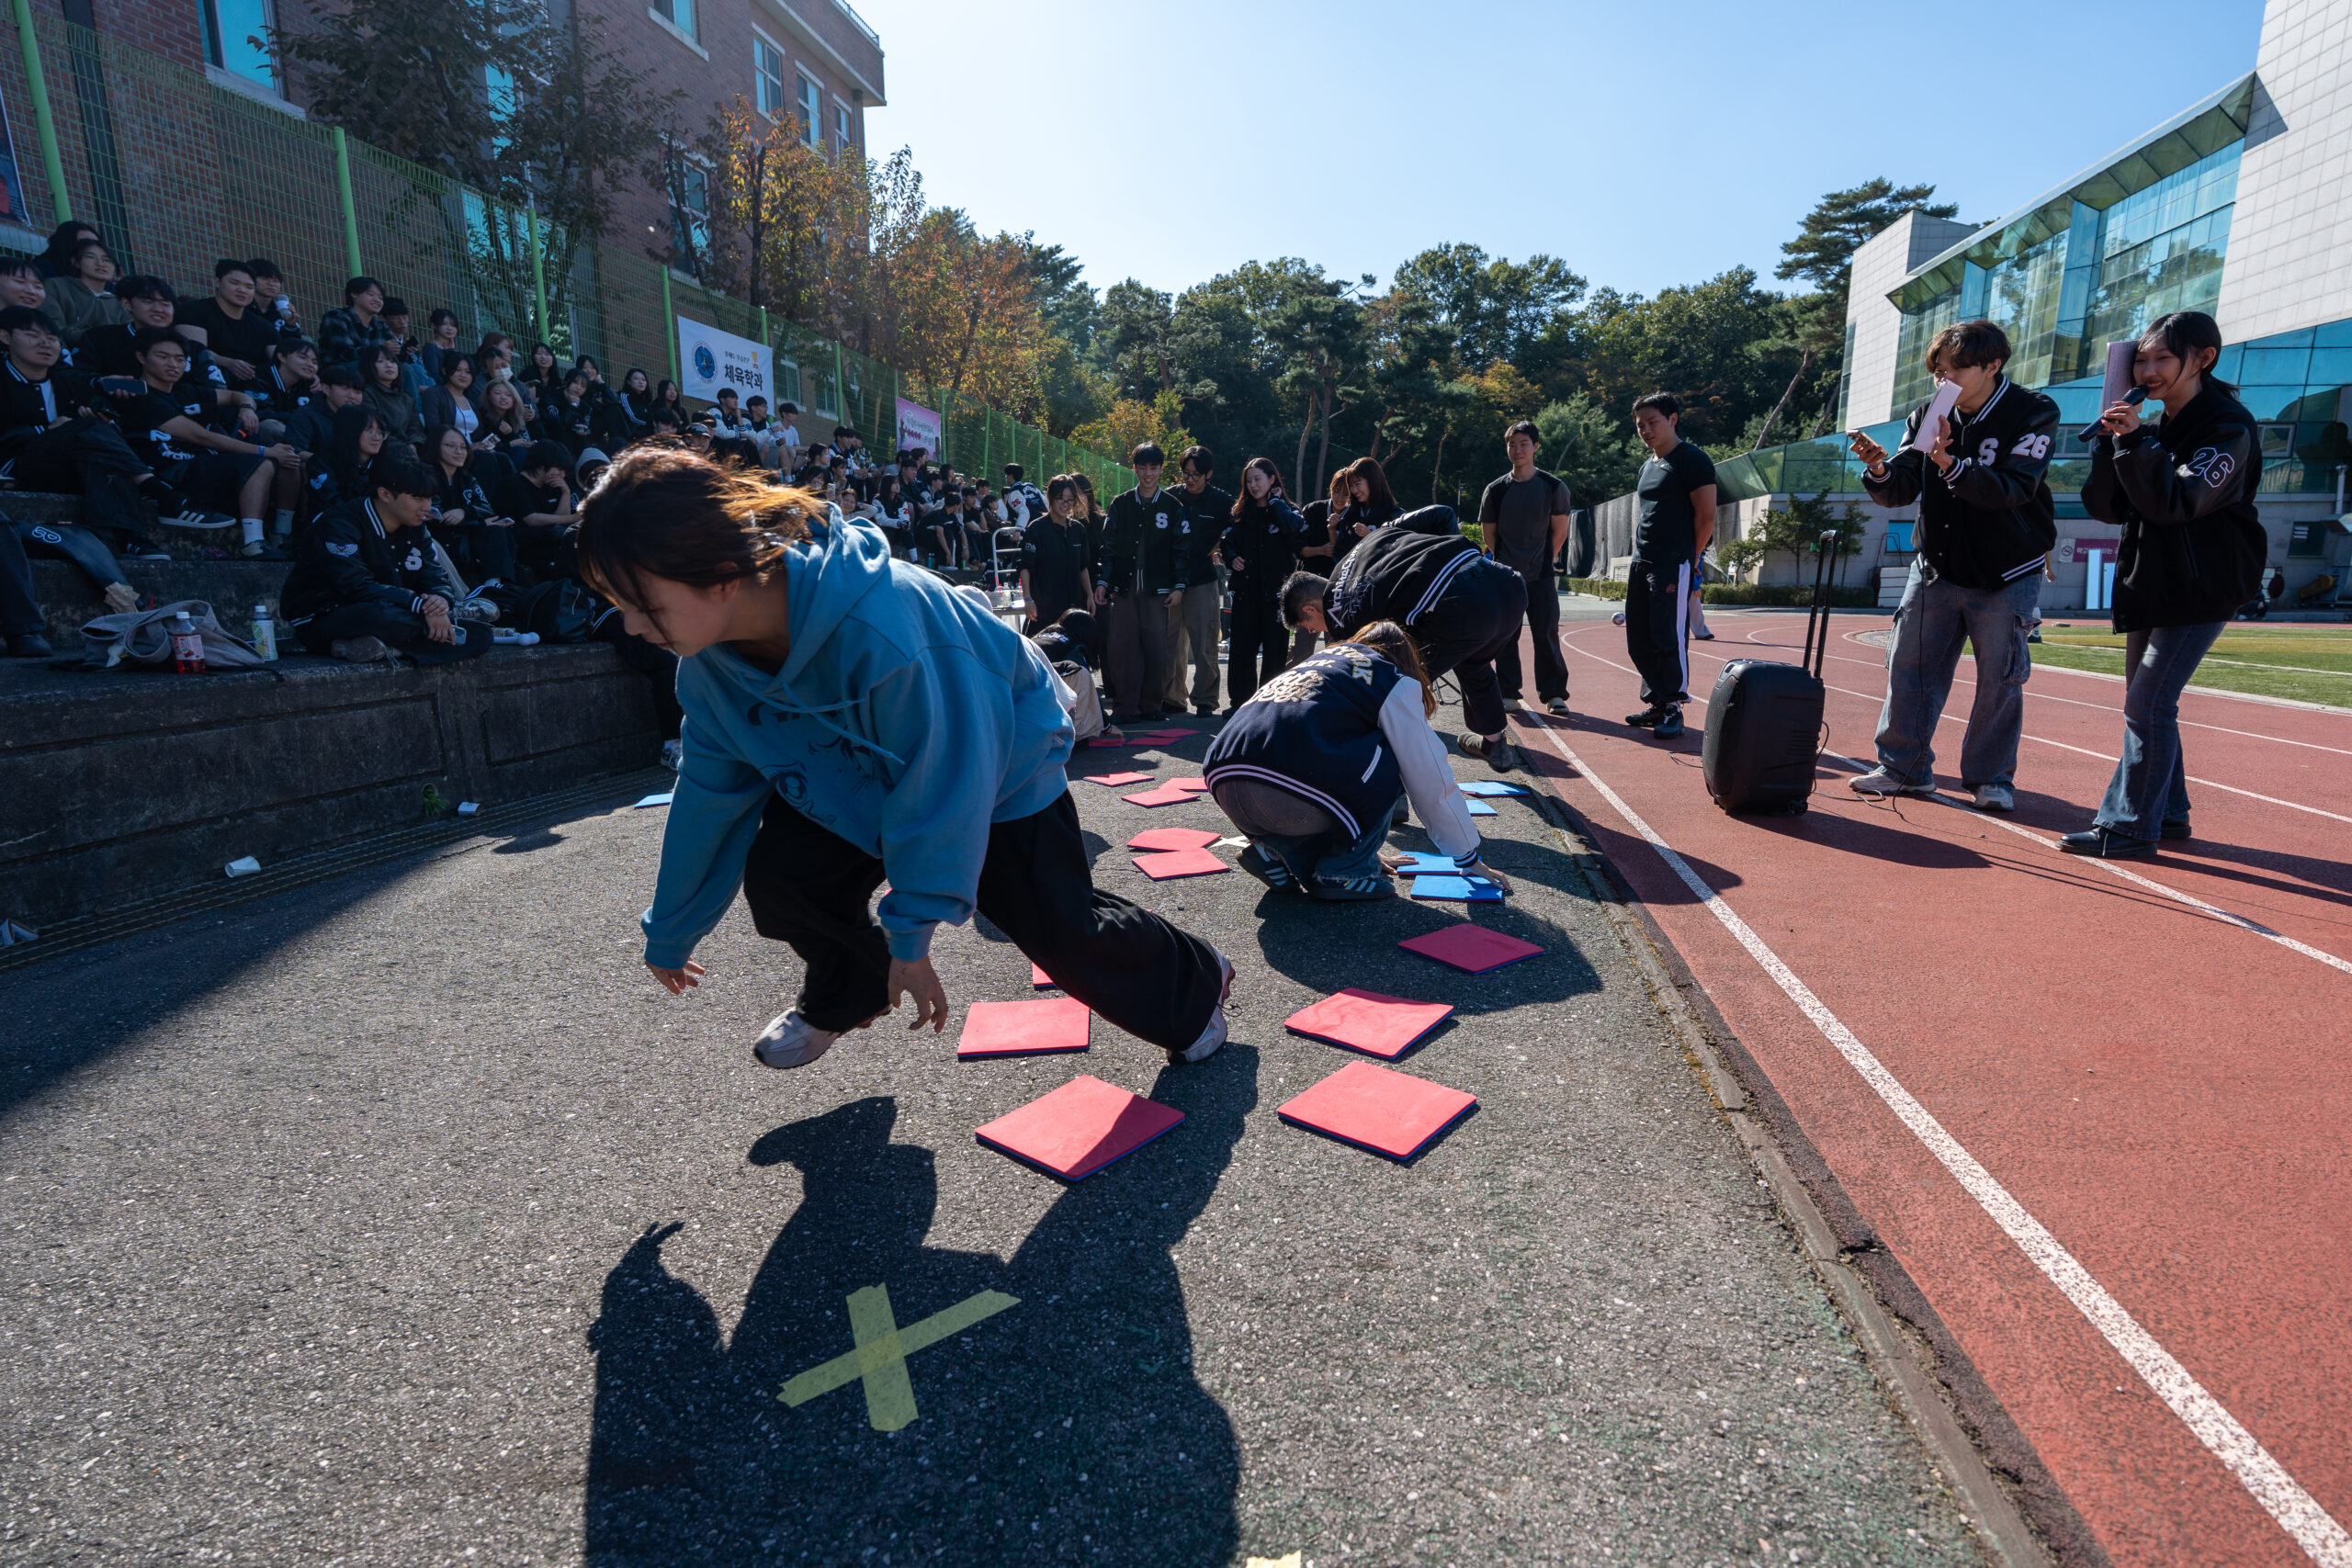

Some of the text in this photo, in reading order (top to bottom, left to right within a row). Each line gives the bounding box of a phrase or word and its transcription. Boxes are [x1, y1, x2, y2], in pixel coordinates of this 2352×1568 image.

[724, 364, 763, 390] 체육학과
[1978, 437, 1999, 467] S
[2010, 433, 2051, 460] 26
[2187, 447, 2235, 488] 26
[1155, 512, 1169, 528] S
[404, 547, 423, 570] S
